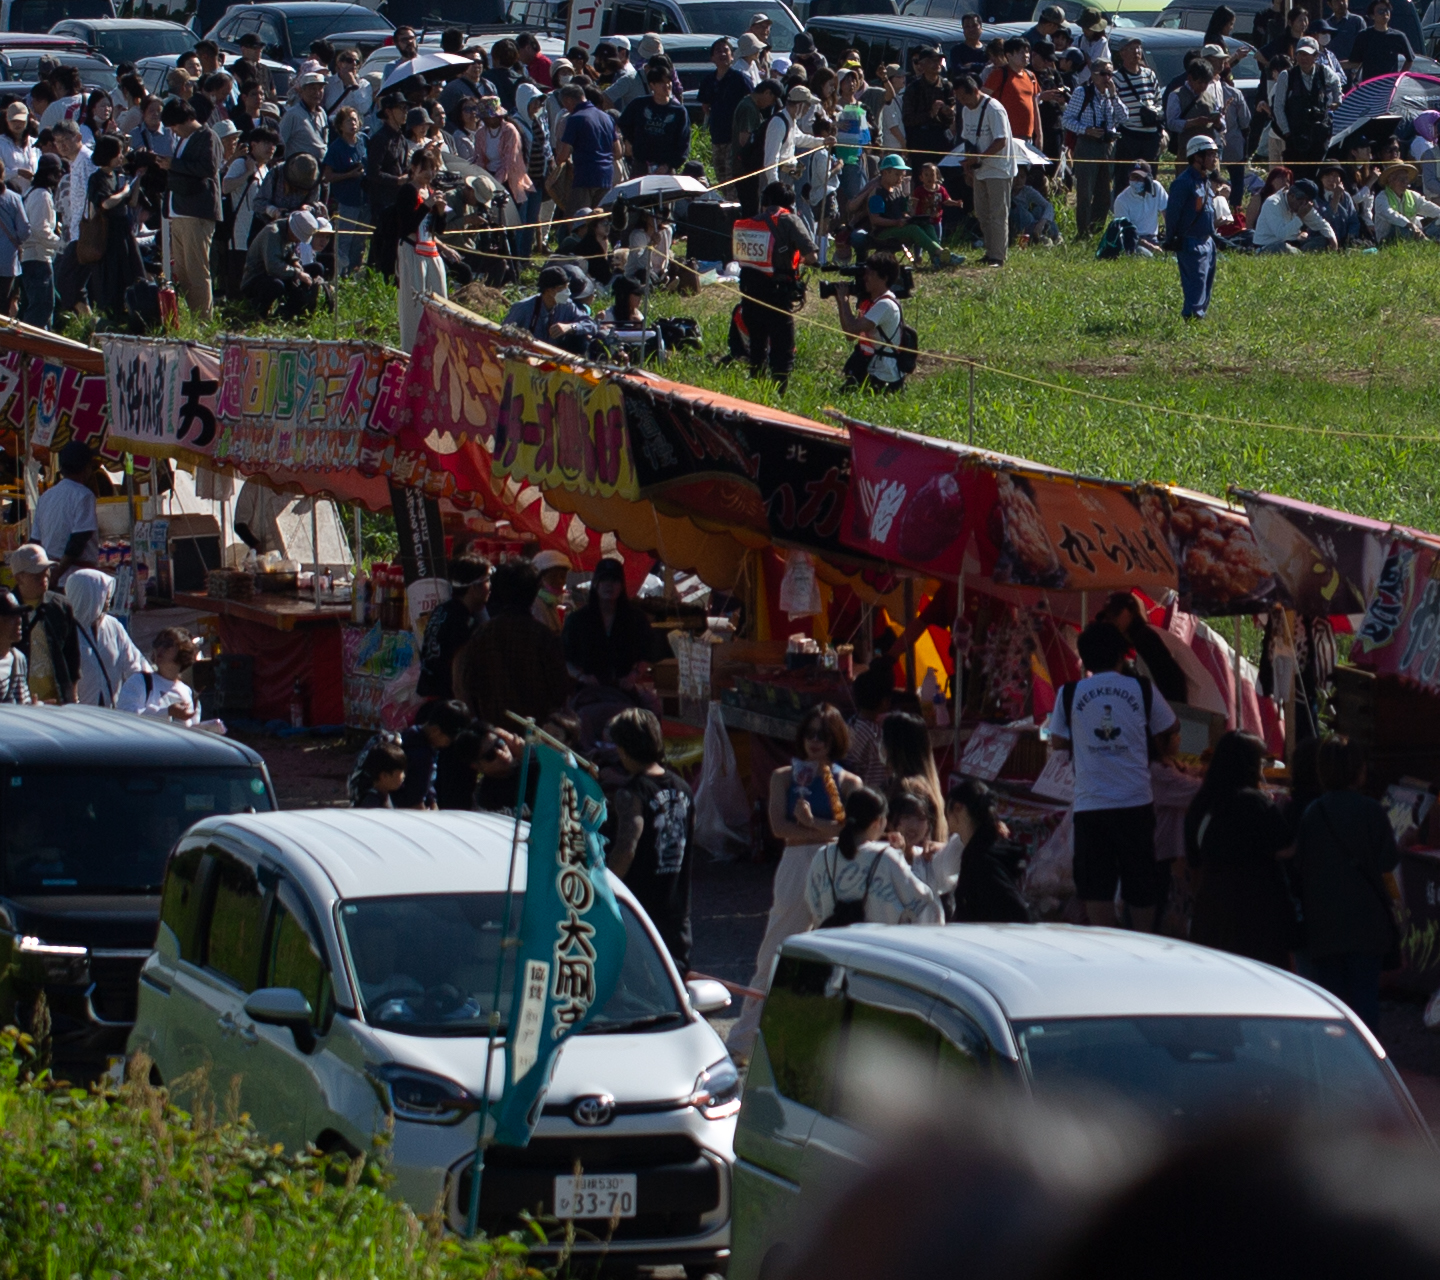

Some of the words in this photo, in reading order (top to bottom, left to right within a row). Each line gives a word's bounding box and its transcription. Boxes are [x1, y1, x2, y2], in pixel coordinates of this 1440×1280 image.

[735, 241, 765, 257] PRESS
[1075, 686, 1141, 713] WEEKENDER
[573, 1192, 632, 1214] 33-70
